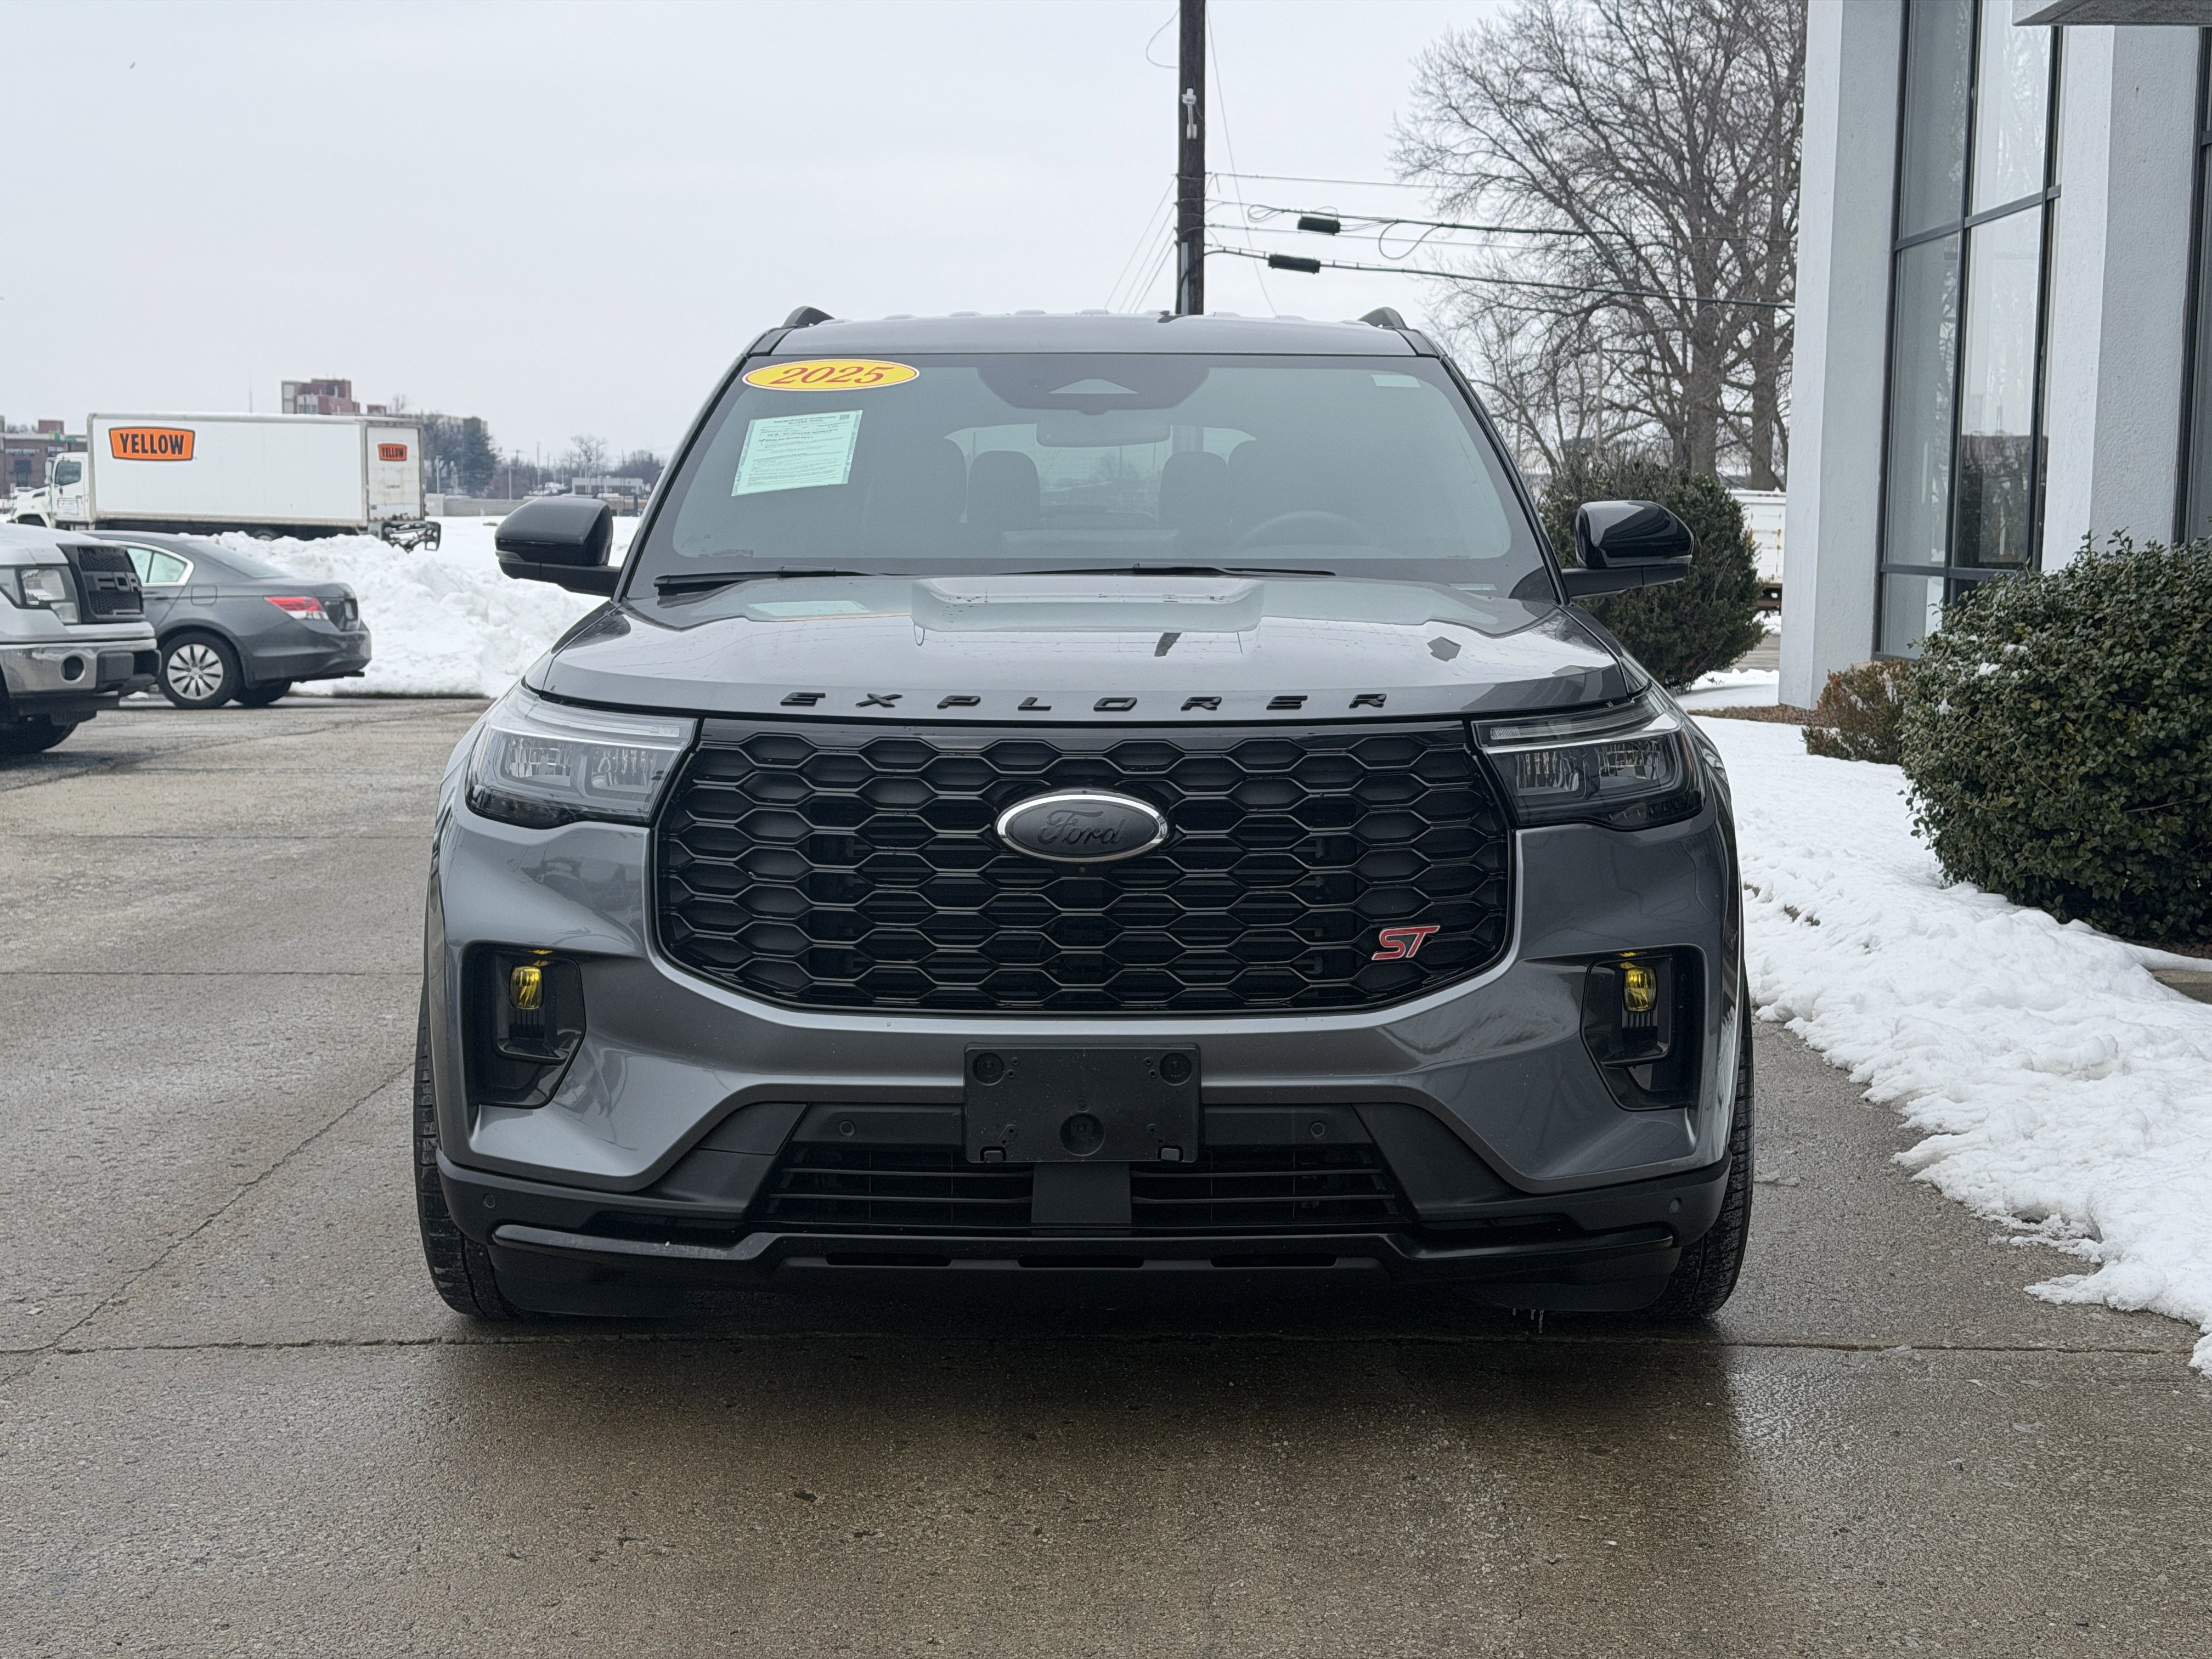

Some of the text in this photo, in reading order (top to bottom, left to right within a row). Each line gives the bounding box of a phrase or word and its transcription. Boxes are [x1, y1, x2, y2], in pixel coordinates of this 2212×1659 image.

[768, 366, 895, 384] 2025
[120, 433, 184, 455] YELLOW
[382, 447, 404, 458] YELLOW
[780, 692, 1387, 712] EXPLORER
[1037, 809, 1128, 845] Ford
[1372, 925, 1441, 961] ST
